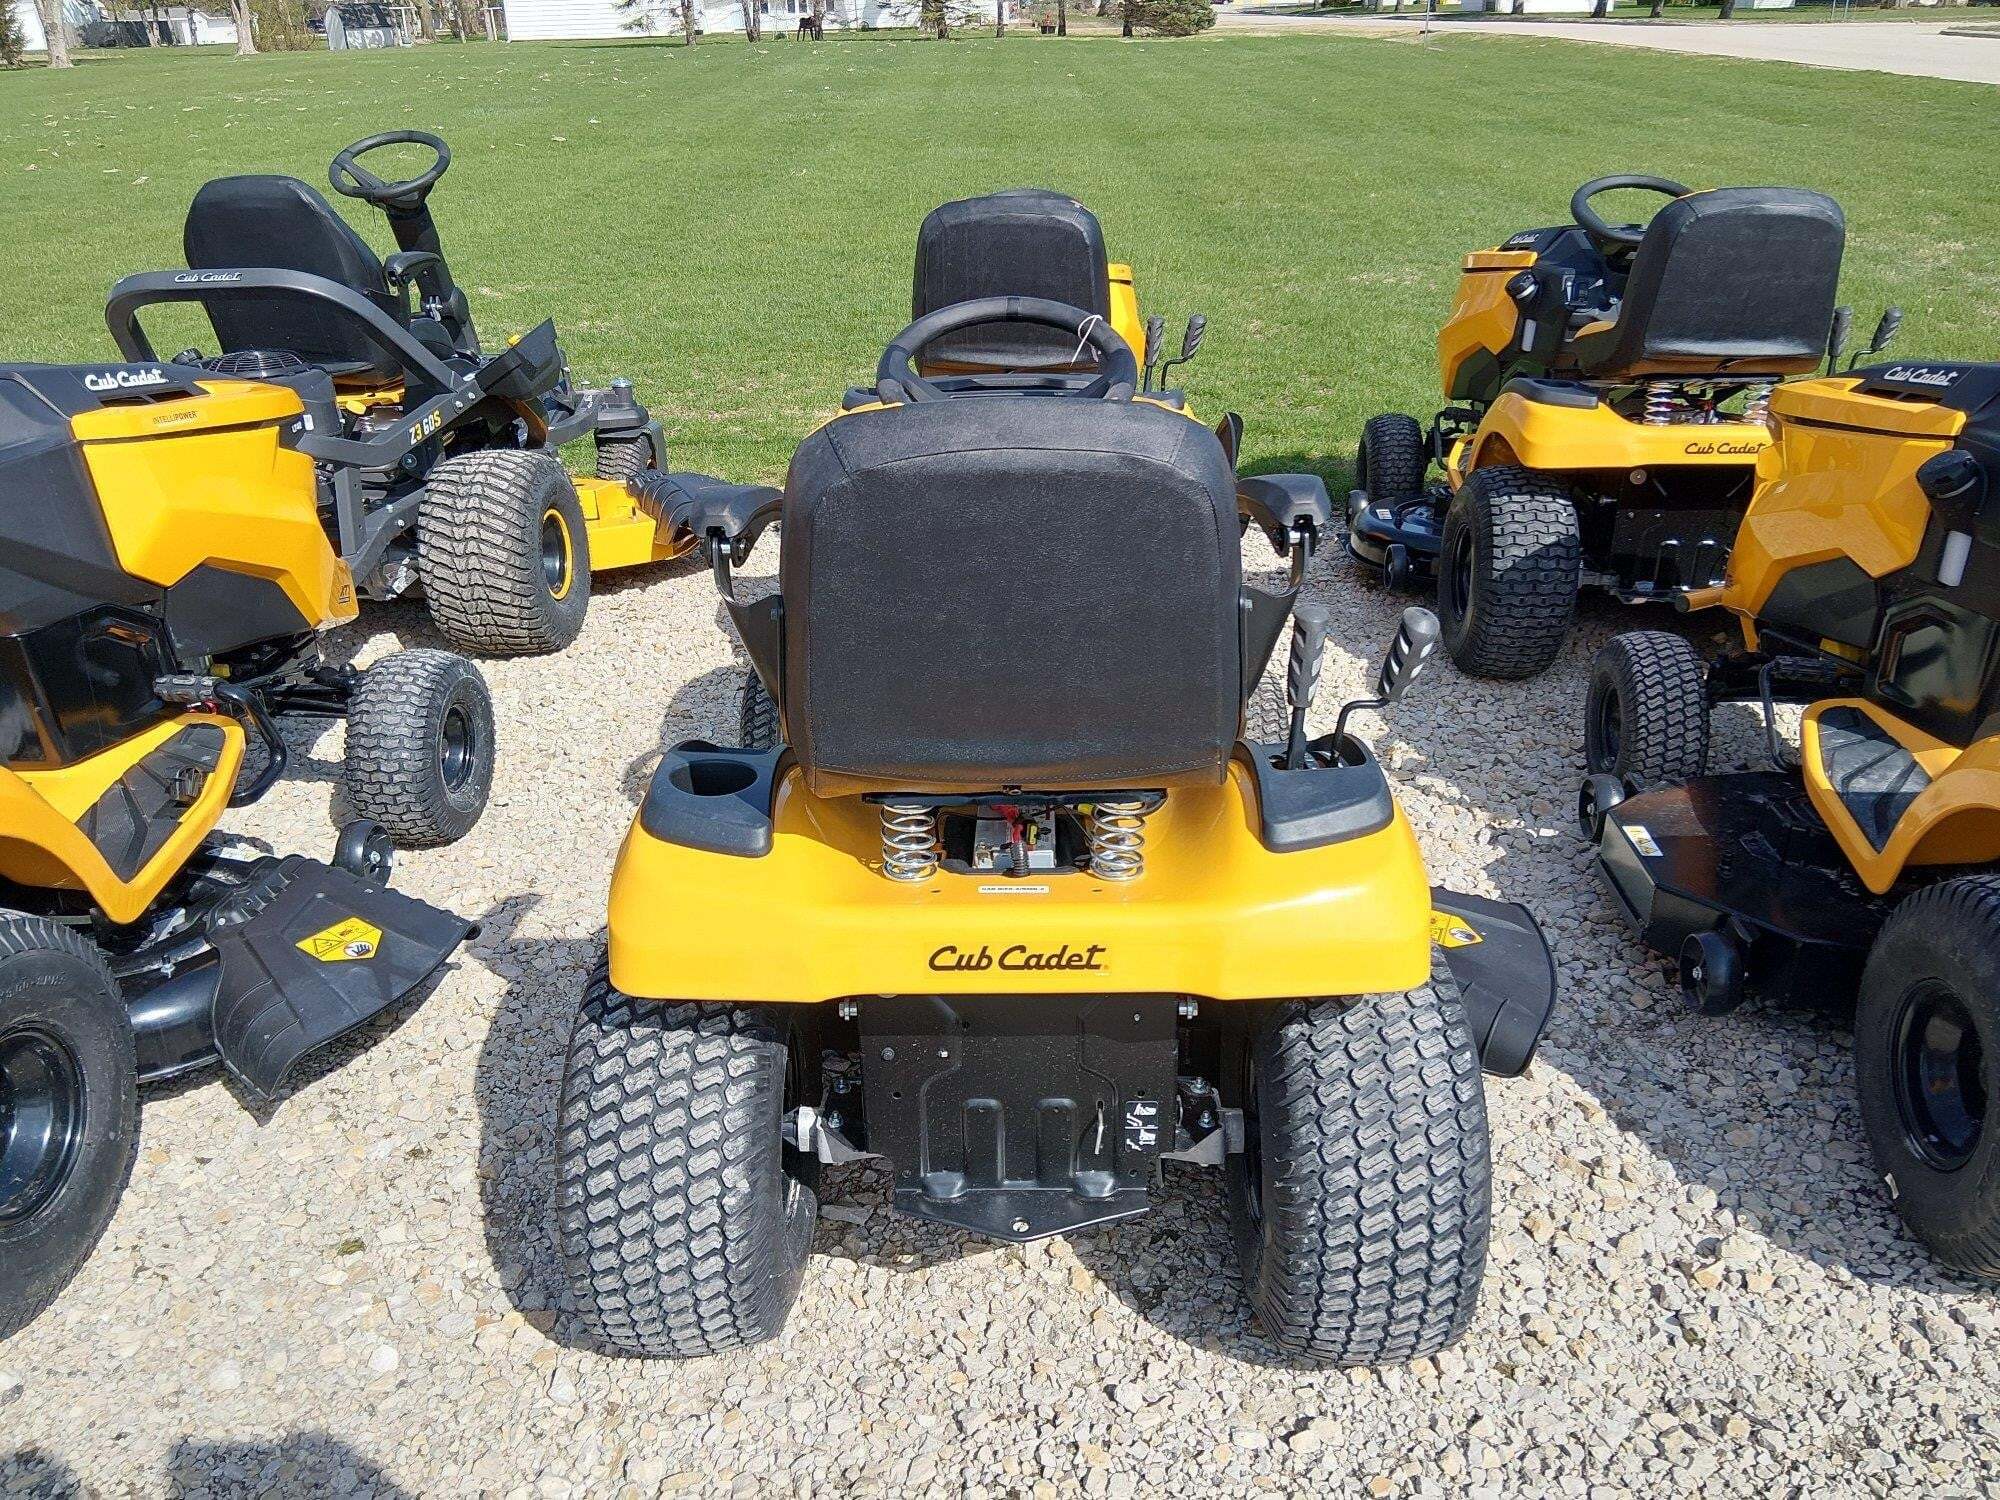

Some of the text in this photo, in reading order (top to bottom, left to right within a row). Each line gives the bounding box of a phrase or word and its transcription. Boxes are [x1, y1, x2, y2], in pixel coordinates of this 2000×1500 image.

[174, 272, 242, 282] Cub Cadet
[84, 368, 165, 391] Cub Cadet
[1884, 366, 1959, 386] Cub Cadet
[152, 411, 198, 425] INTELLIPOWER
[409, 410, 442, 446] Z3 60S
[1684, 442, 1766, 454] Cub Cadet
[928, 944, 1106, 971] Cub Cadet
